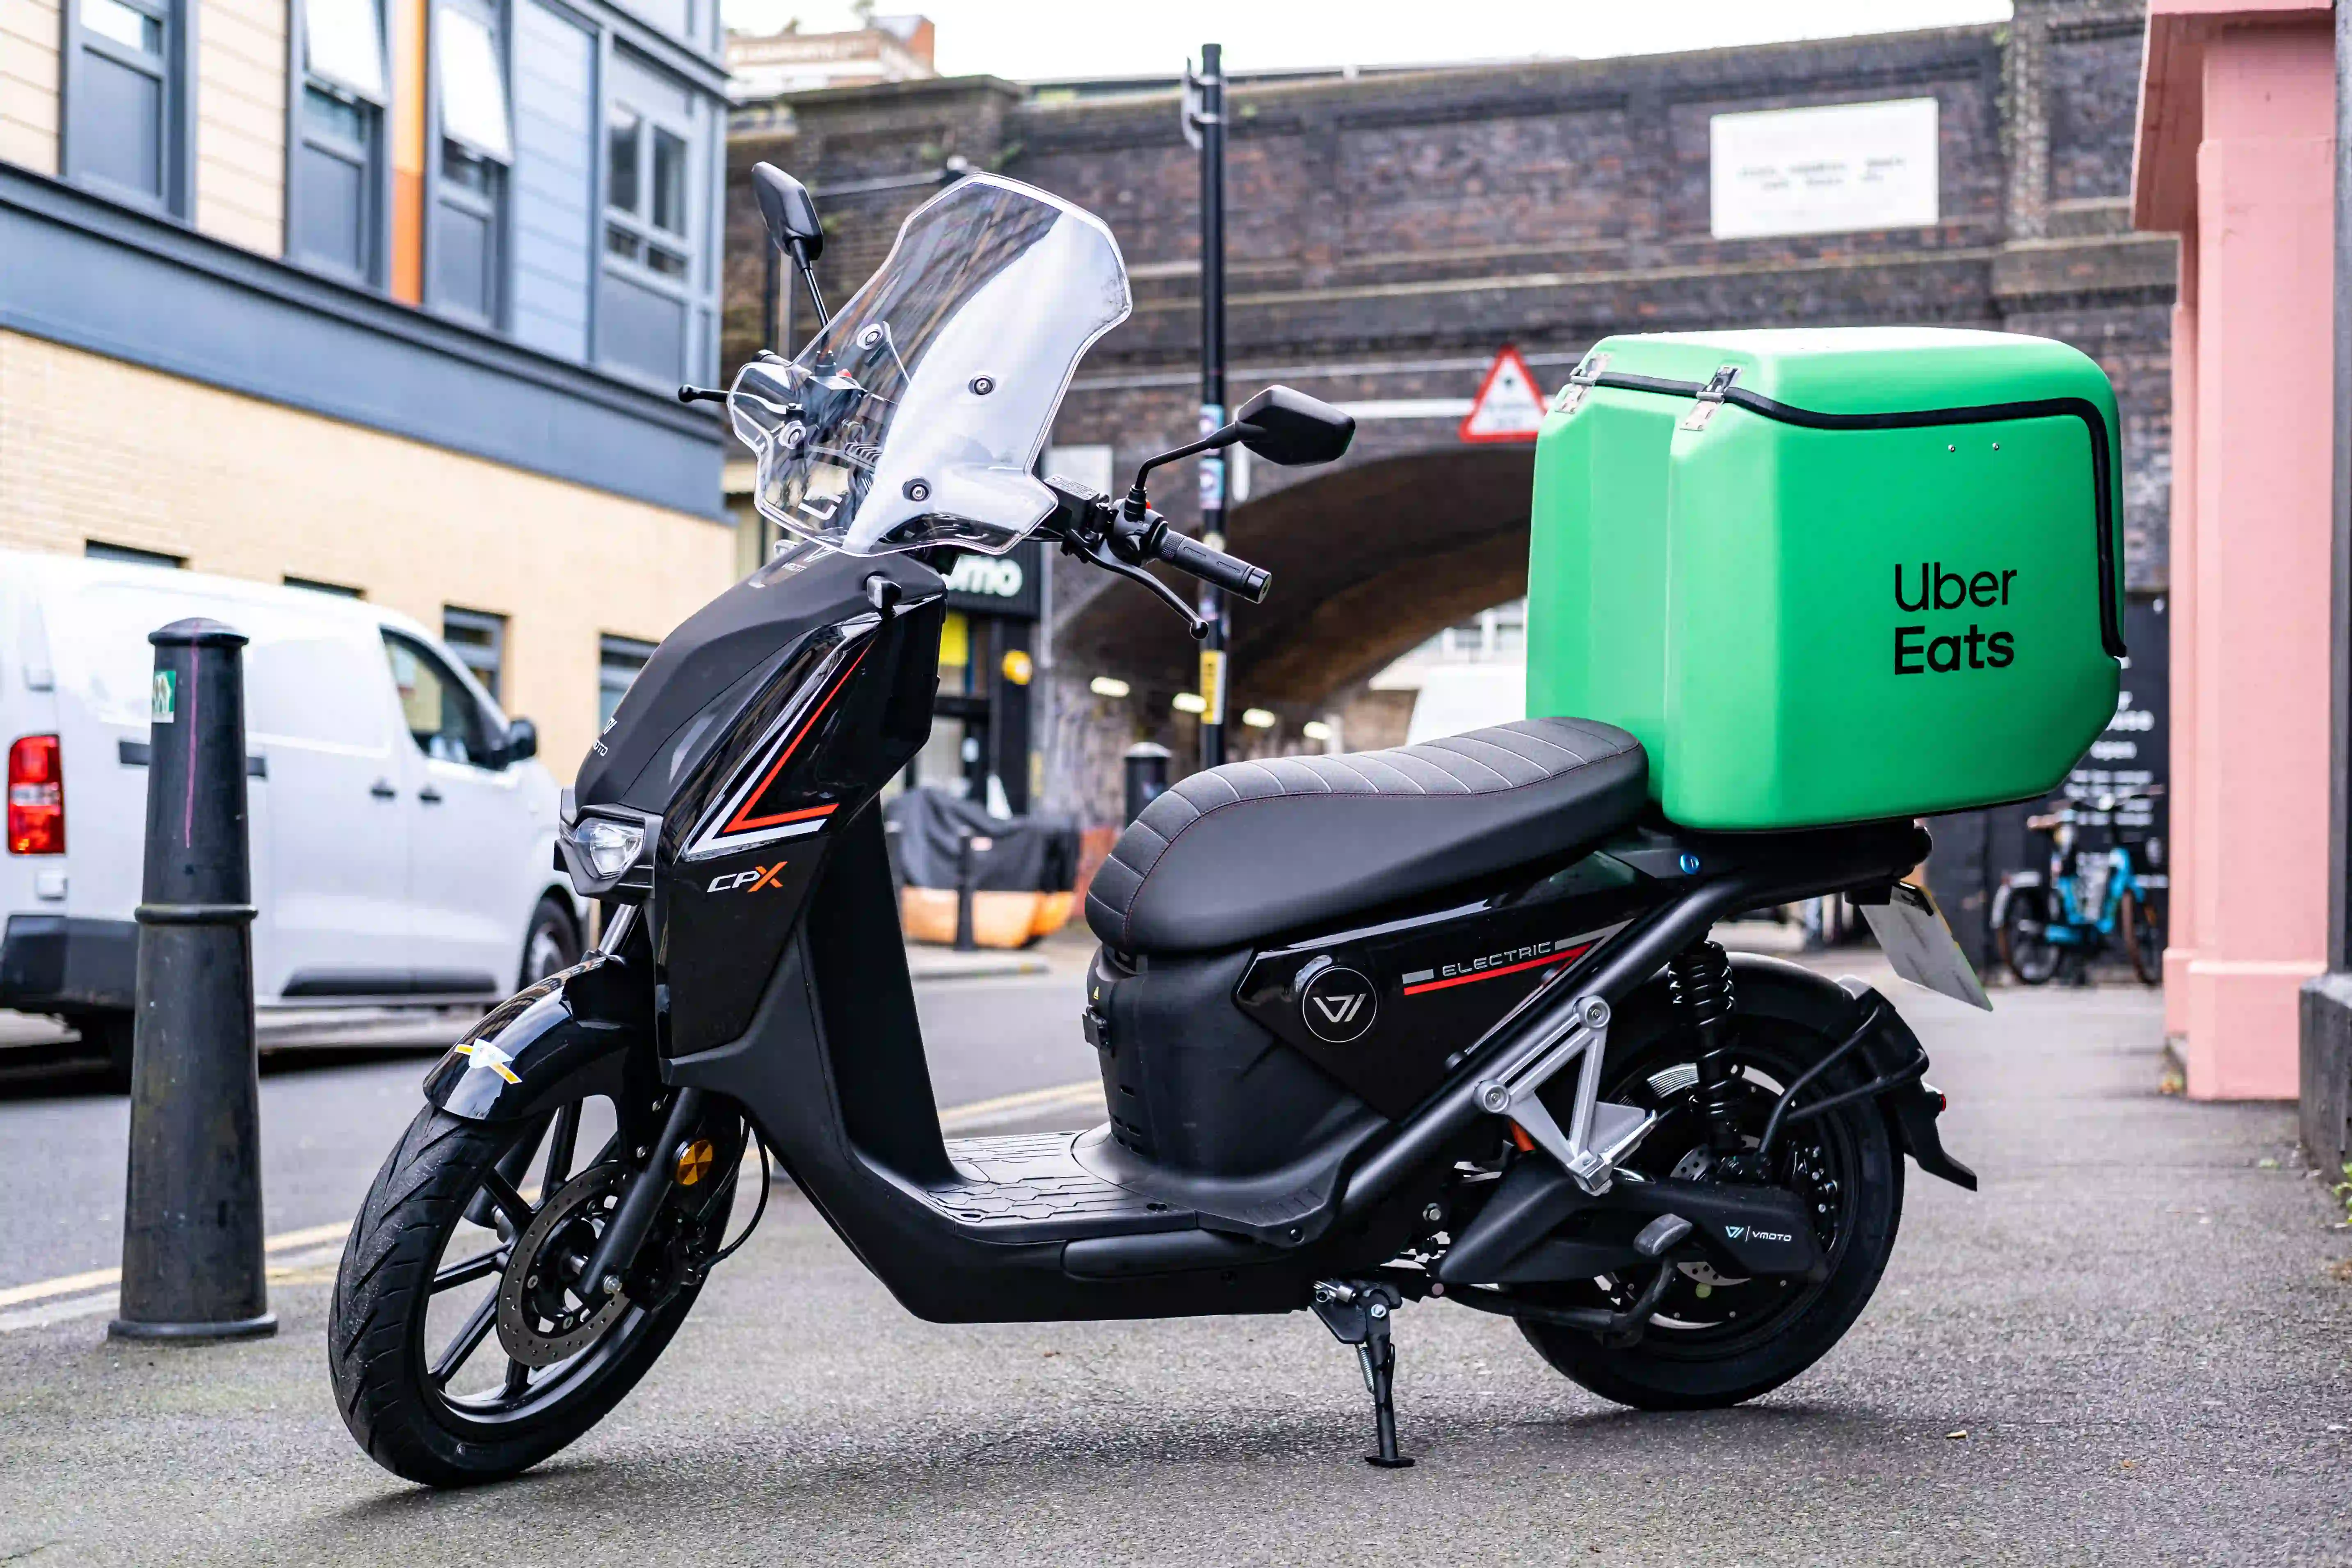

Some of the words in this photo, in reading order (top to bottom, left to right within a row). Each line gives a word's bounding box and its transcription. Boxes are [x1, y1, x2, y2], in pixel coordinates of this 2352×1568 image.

[1895, 562, 2017, 612] Uber
[1894, 624, 2014, 675] Eats
[707, 861, 788, 893] CPX
[1442, 941, 1552, 977] ELECTRIC
[1752, 1230, 1792, 1242] VMOTO
